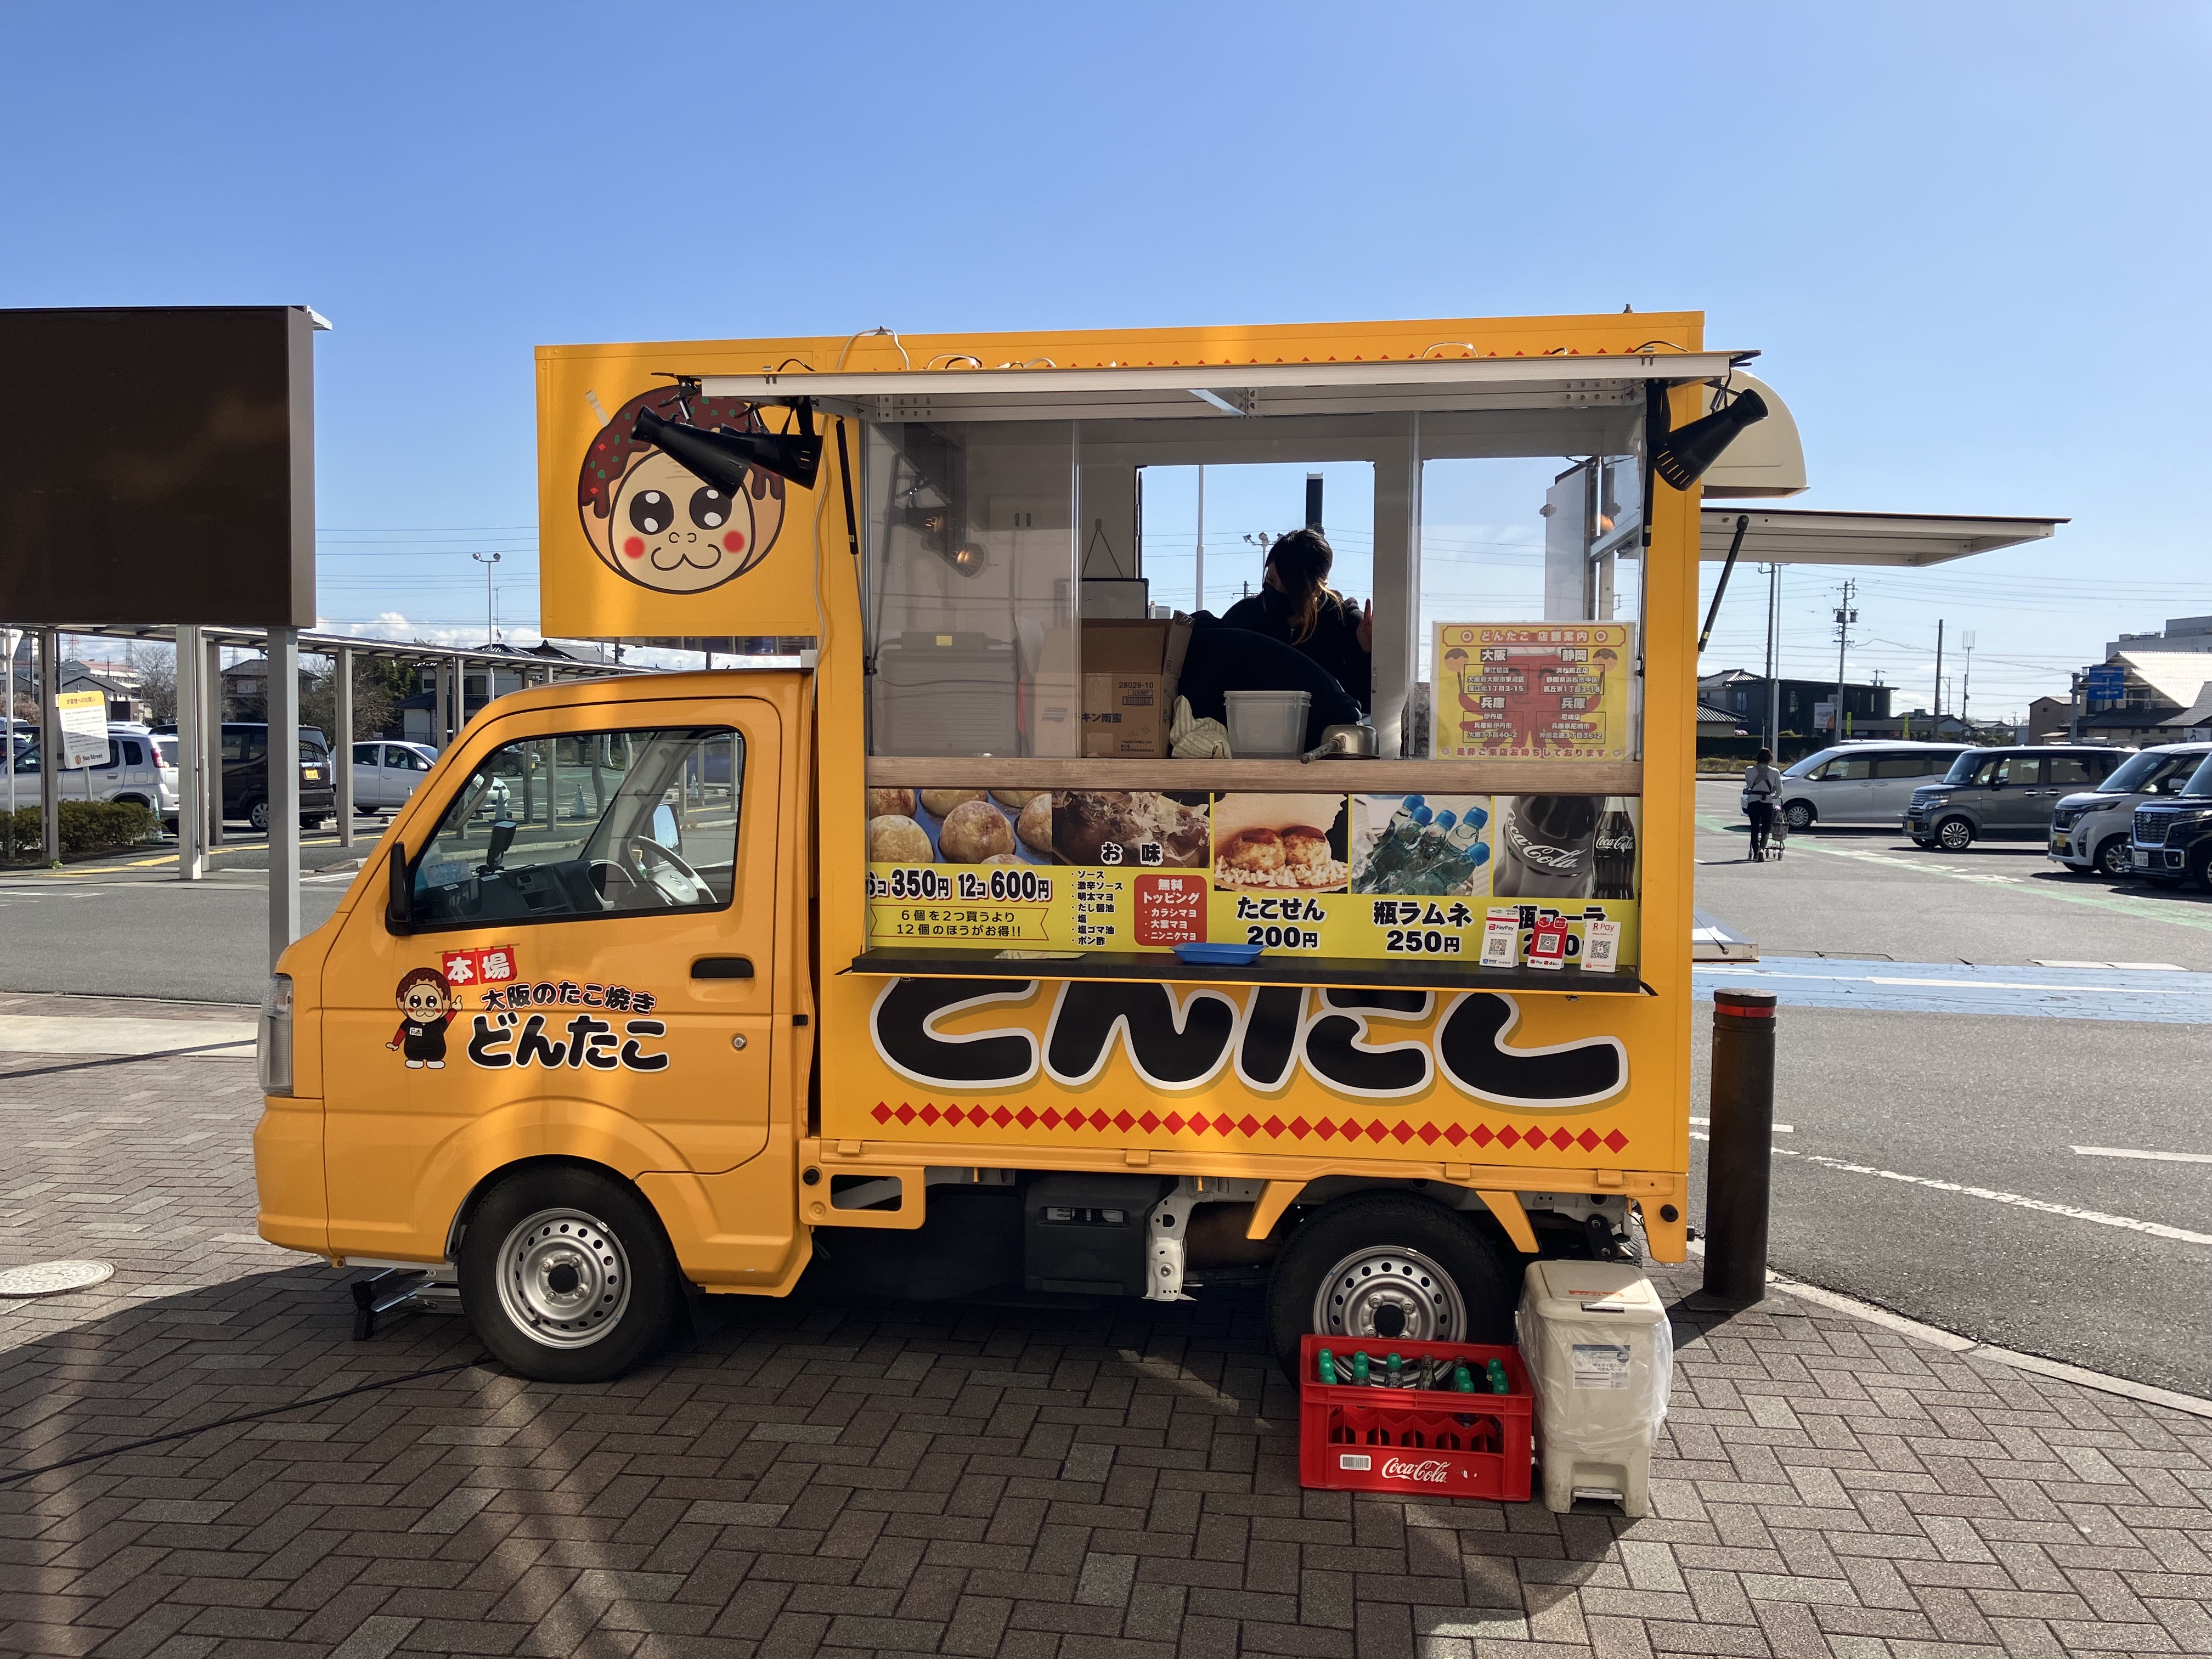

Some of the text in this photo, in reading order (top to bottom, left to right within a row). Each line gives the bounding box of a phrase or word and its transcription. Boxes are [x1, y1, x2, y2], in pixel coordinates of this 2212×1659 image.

[1481, 631, 1588, 642] どんたこ 店舗案内
[1482, 649, 1506, 662] 大阪
[1562, 649, 1587, 662] 静岡
[1481, 697, 1505, 709] 兵庫
[1561, 697, 1586, 709] 兵庫
[1456, 747, 1606, 757] 是非ご来店お待ちしております
[1595, 836, 1634, 850] Coca-Cola
[1077, 870, 1105, 879] ソース
[1077, 881, 1124, 891] 激辛ソース
[1158, 878, 1184, 891] 無料
[1077, 892, 1115, 902] 明太マヨ
[1143, 891, 1200, 905] トッピング
[1077, 903, 1116, 913] だし醤油
[1151, 908, 1198, 918] カラシマヨ
[1236, 895, 1326, 922] たこせん
[1373, 900, 1473, 928] 瓶ラムネ
[901, 910, 1015, 923] 6個を2つ買うより
[1077, 914, 1087, 923] 塩
[1150, 919, 1188, 929] 大葉マヨ
[1600, 923, 1615, 932] Pay
[1077, 926, 1115, 935] 塩ゴマ油
[1150, 932, 1197, 941] ニンニクマヨ
[1077, 936, 1107, 946] ポン酢
[1246, 925, 1318, 949] 200円
[1386, 929, 1460, 953] 250円
[447, 952, 511, 984] 本場
[481, 981, 657, 1015] 大阪のたこ焼き
[467, 1012, 670, 1073] どんたこ
[1381, 1457, 1452, 1482] Coca-Cola
